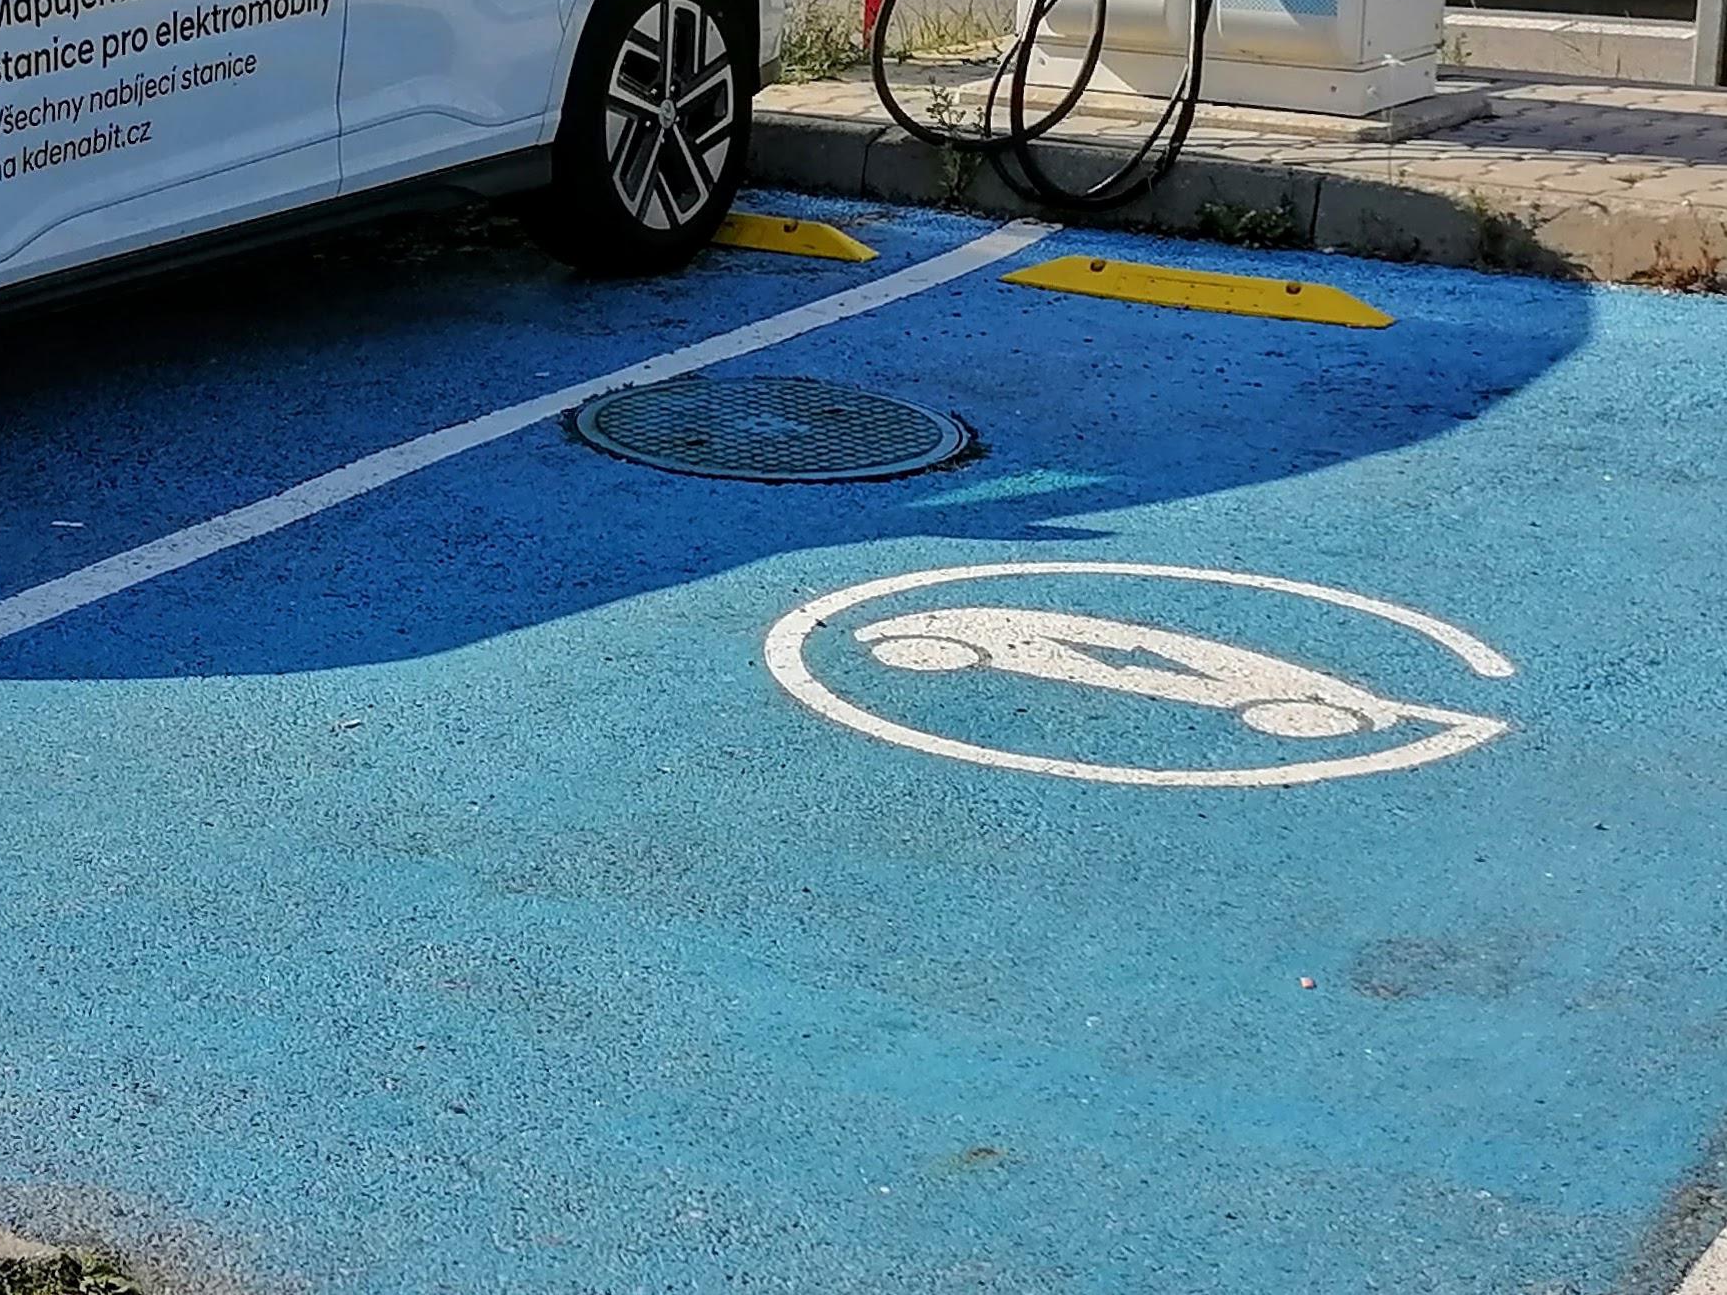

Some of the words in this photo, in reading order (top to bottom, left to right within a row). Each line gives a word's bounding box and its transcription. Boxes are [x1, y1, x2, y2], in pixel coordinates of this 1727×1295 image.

[101, 26, 149, 68] pro
[89, 65, 177, 113] nabíjecí
[180, 52, 257, 91] stanice
[22, 120, 153, 175] kdenabit.cz
